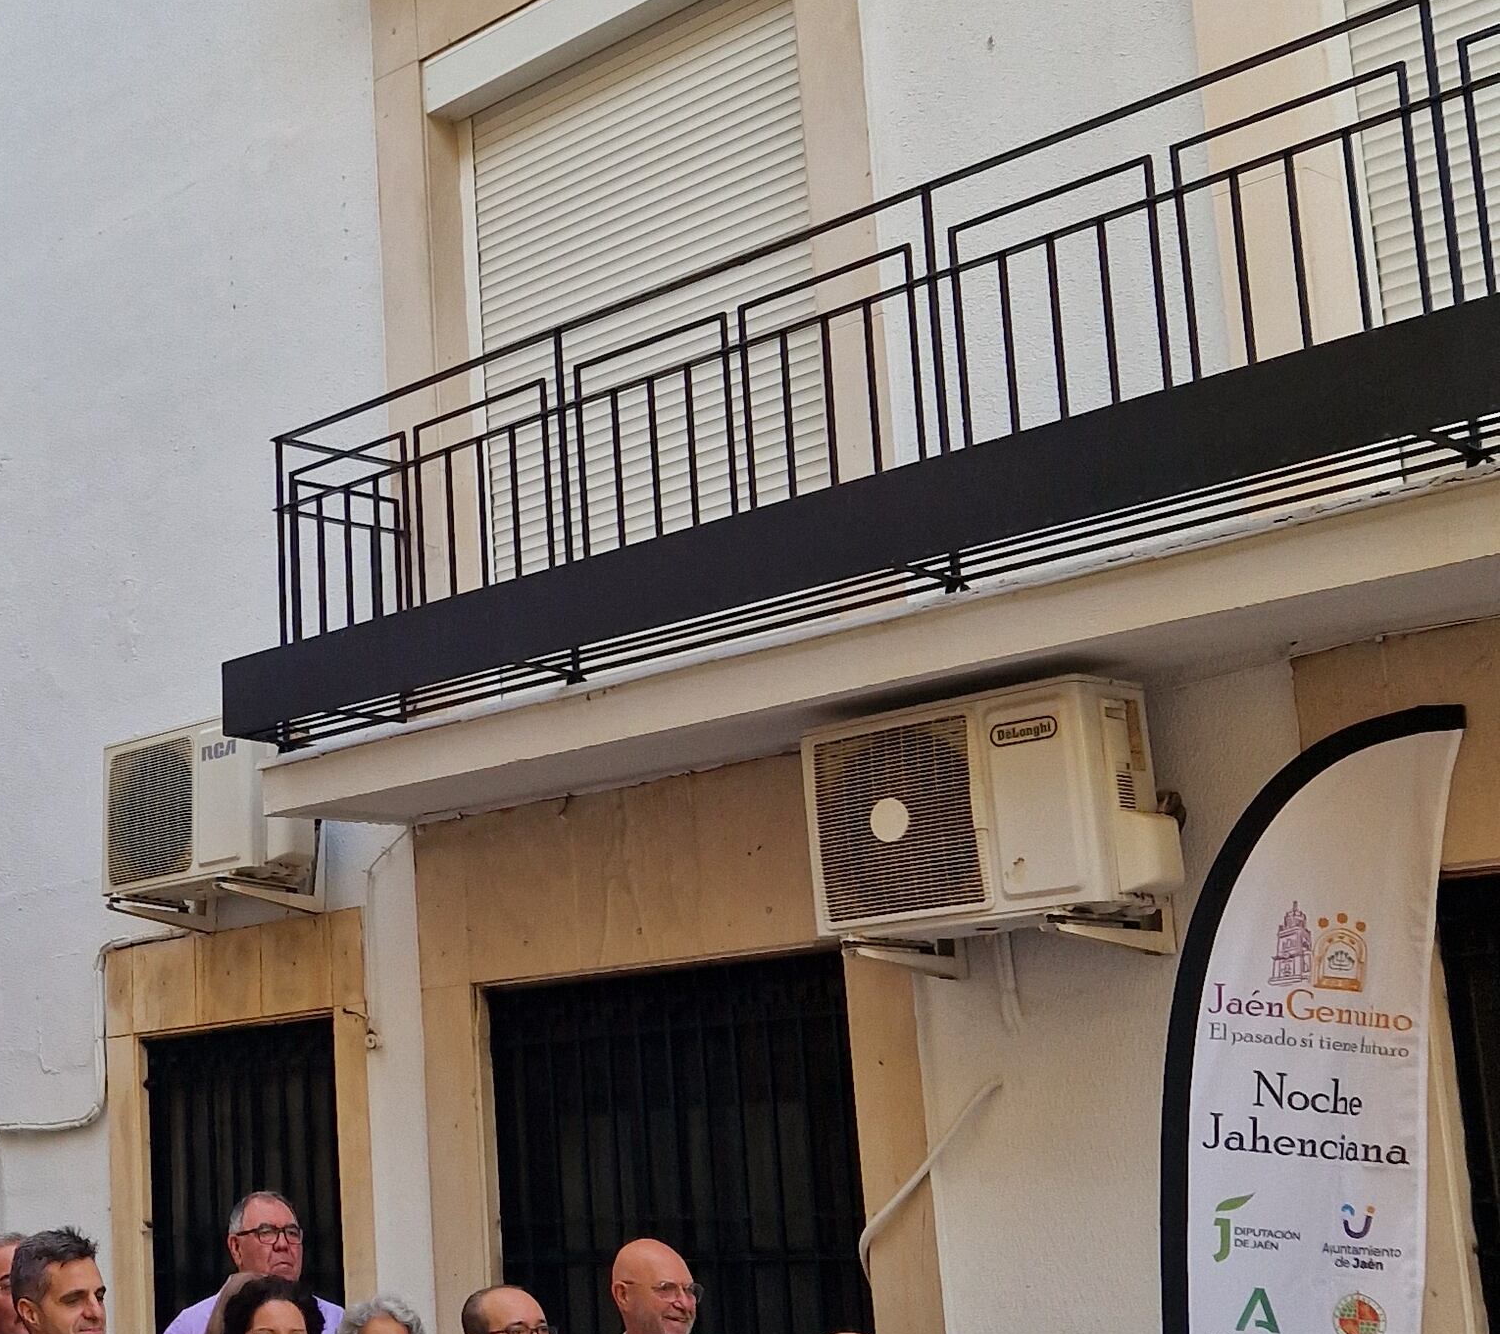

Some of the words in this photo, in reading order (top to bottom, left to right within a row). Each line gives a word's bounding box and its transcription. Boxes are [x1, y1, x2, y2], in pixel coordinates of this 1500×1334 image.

[201, 739, 237, 761] RCA
[1209, 1022, 1227, 1040] El
[1231, 1028, 1297, 1046] pasado
[1300, 1033, 1314, 1048] sí
[1319, 1035, 1358, 1053] tiene
[1253, 1070, 1363, 1116] Noche
[1202, 1112, 1410, 1165] Jahenciana
[1234, 1239, 1249, 1247] DE
[1334, 1257, 1350, 1268] de
[1352, 1257, 1384, 1270] Jaén
